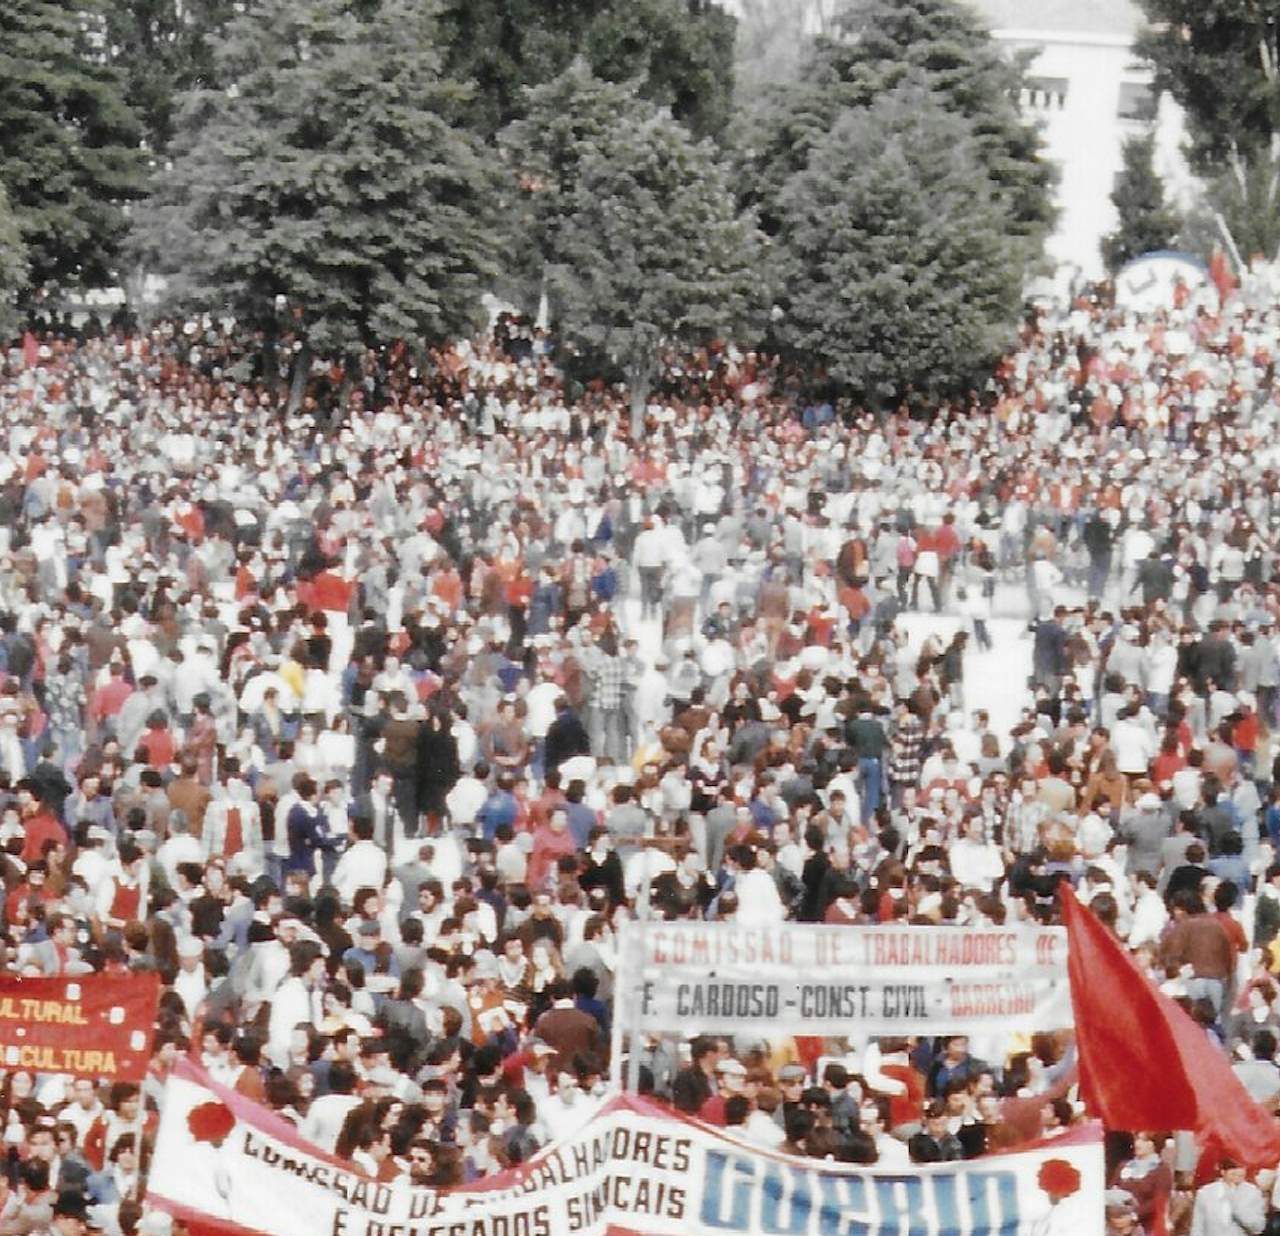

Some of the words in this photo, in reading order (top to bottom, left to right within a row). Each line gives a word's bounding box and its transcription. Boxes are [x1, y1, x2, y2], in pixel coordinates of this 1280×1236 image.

[816, 932, 845, 966] DE
[862, 932, 1018, 966] TRABALHADORES
[677, 984, 779, 1018] CARDOSO
[882, 984, 929, 1018] CIVIL
[21, 1048, 117, 1074] CULTURA
